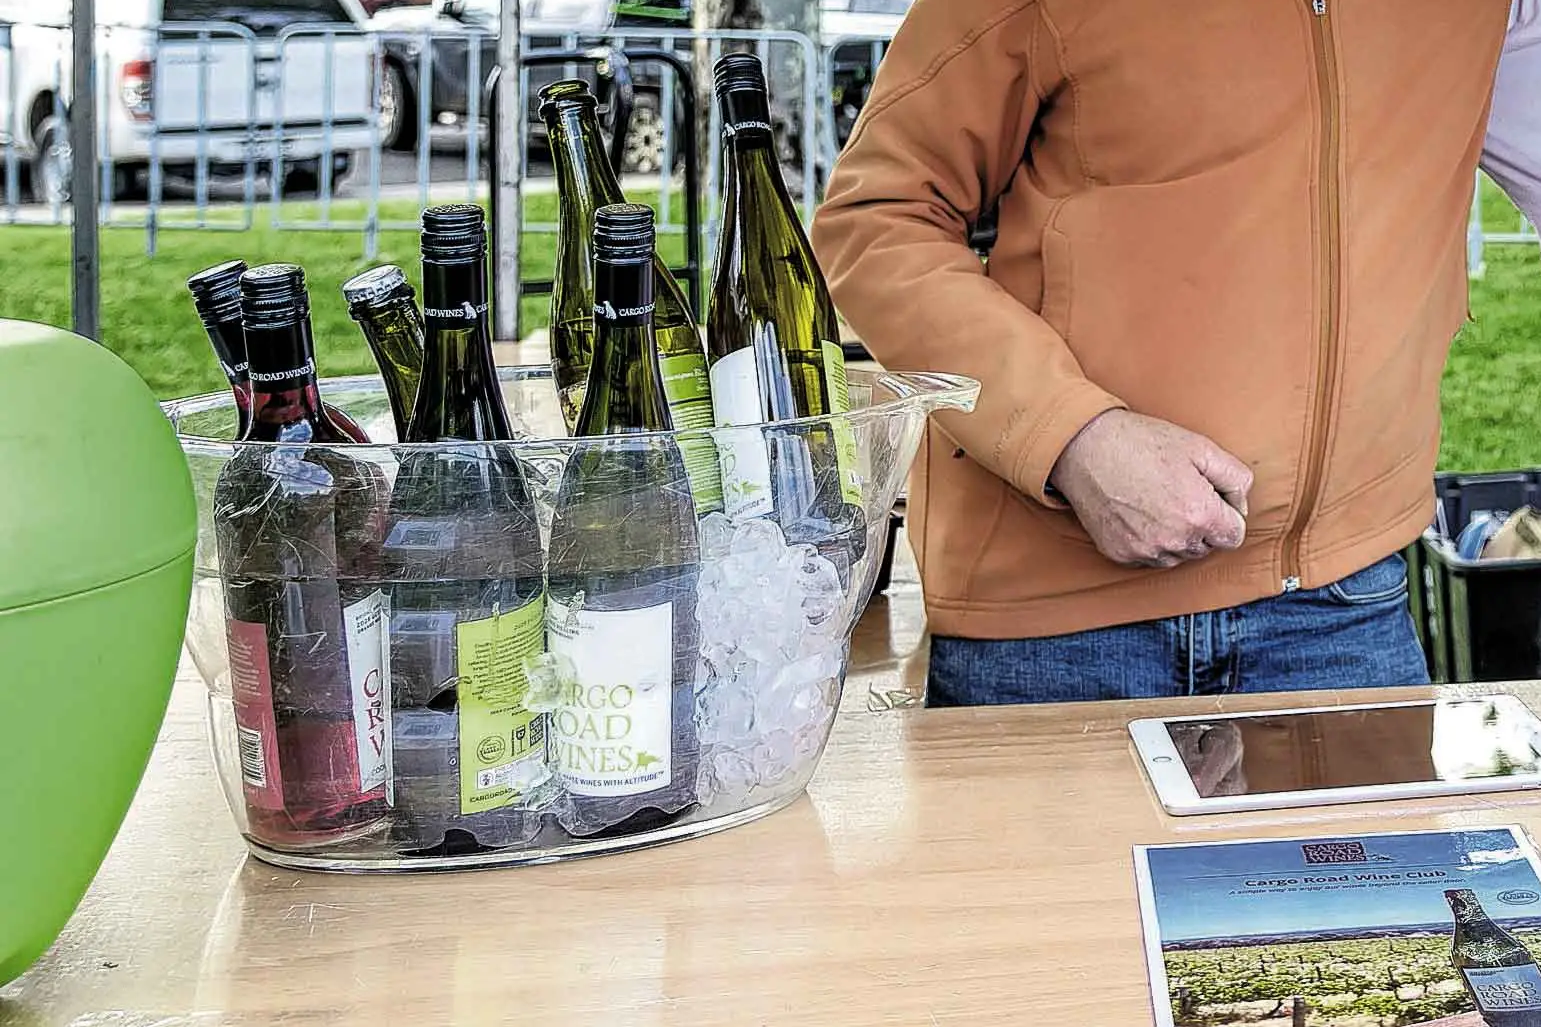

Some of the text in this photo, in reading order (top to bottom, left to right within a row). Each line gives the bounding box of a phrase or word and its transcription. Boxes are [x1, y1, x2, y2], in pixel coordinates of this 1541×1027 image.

[436, 308, 464, 318] WINES
[619, 307, 645, 317] CARGO
[258, 372, 285, 381] ROAD
[580, 778, 602, 787] WINES
[603, 779, 623, 787] WITH
[1305, 843, 1360, 851] CARGO
[1307, 848, 1362, 856] ROAD
[1308, 854, 1366, 862] WINES
[1245, 870, 1446, 888] Cargo Road Wine Club
[1477, 981, 1534, 992] CARGO
[1480, 988, 1537, 999] ROAD
